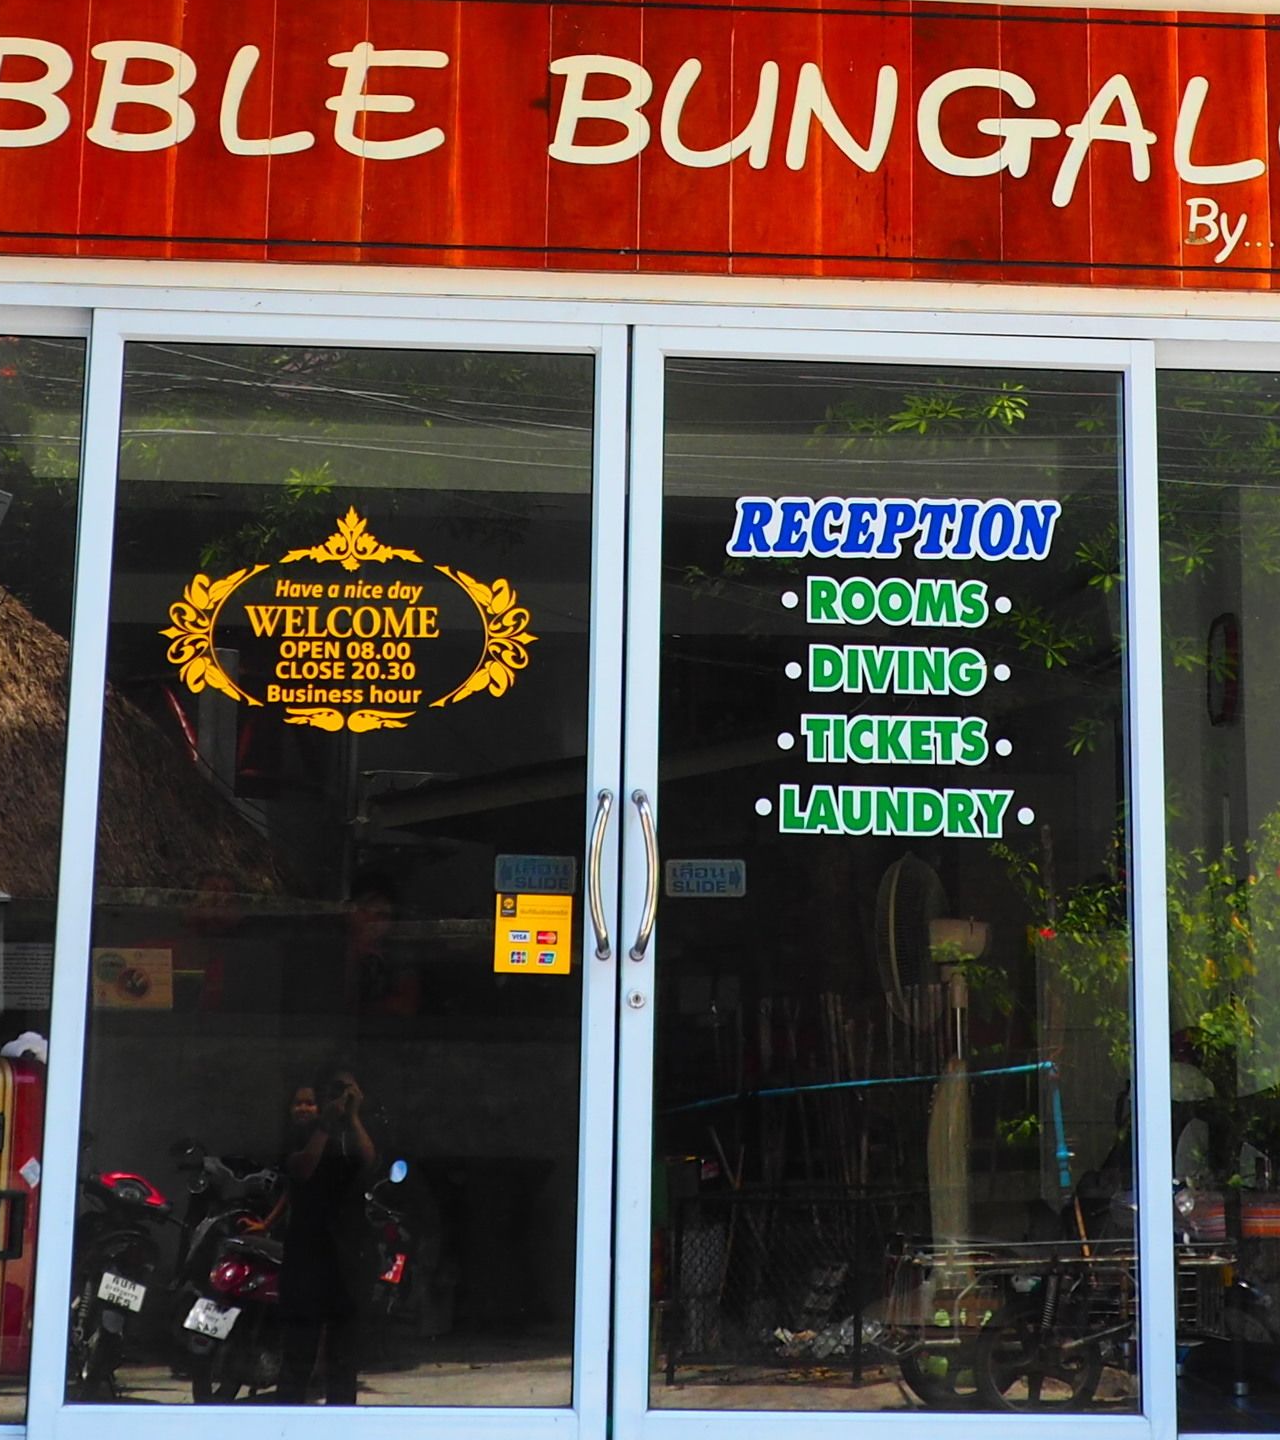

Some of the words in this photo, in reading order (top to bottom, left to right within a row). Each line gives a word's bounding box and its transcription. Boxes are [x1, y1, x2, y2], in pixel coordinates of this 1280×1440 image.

[729, 498, 1060, 559] RECEPTION
[275, 580, 322, 599] Have
[328, 584, 338, 598] a
[344, 581, 384, 599] nice
[388, 581, 423, 604] day
[807, 577, 987, 627] ROOMS
[244, 605, 440, 639] WELCOME
[280, 641, 340, 659] OPEN
[348, 642, 410, 660] 08.00
[275, 661, 345, 680] CLOSE
[351, 662, 416, 680] 20.30
[809, 644, 987, 696] DIVING
[267, 685, 363, 703] Business
[370, 686, 422, 705] hour
[801, 714, 987, 765] TICKETS
[780, 784, 1014, 838] LAUNDRY
[514, 877, 569, 890] SLIDE
[672, 880, 727, 893] SLIDE
